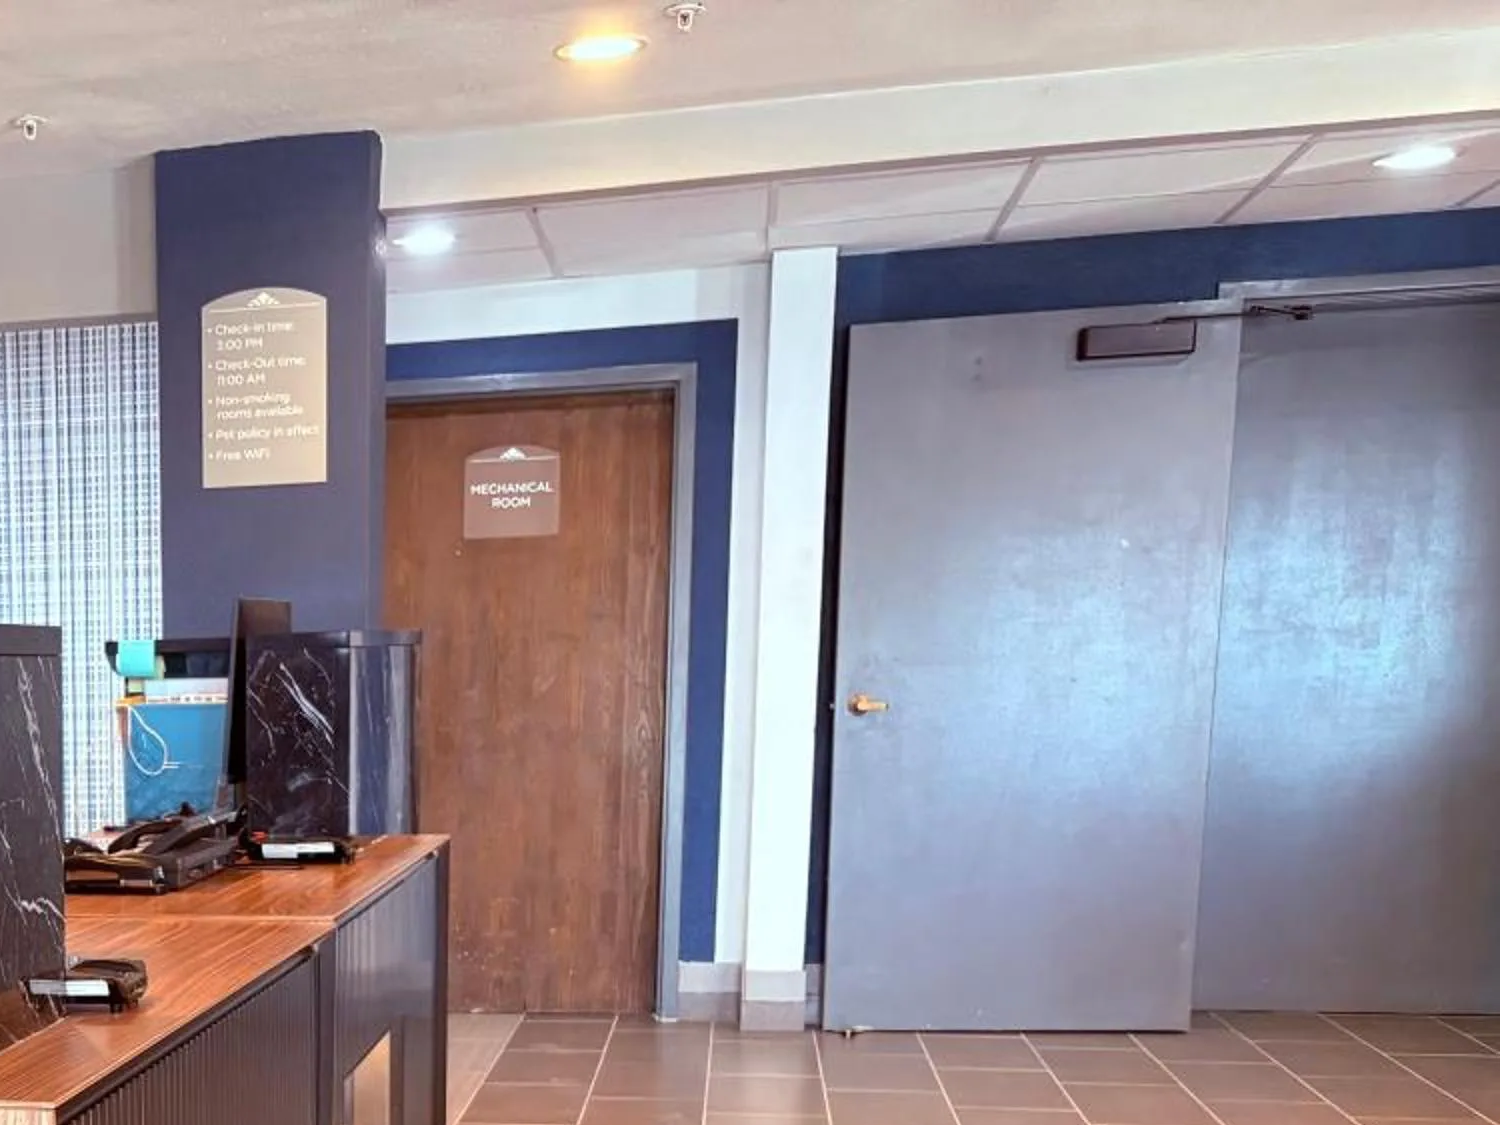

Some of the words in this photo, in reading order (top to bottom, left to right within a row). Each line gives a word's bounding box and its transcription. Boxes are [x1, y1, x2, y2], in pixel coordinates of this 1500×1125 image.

[245, 336, 263, 348] PM
[246, 371, 267, 384] AM
[216, 408, 252, 420] rooms
[254, 405, 304, 417] available
[215, 428, 234, 440] Pet
[237, 426, 271, 441] policy
[273, 425, 284, 437] in
[286, 424, 319, 438] effect
[215, 448, 241, 460] Free
[470, 481, 555, 496] MECHANICAL
[491, 496, 531, 509] ROOM
